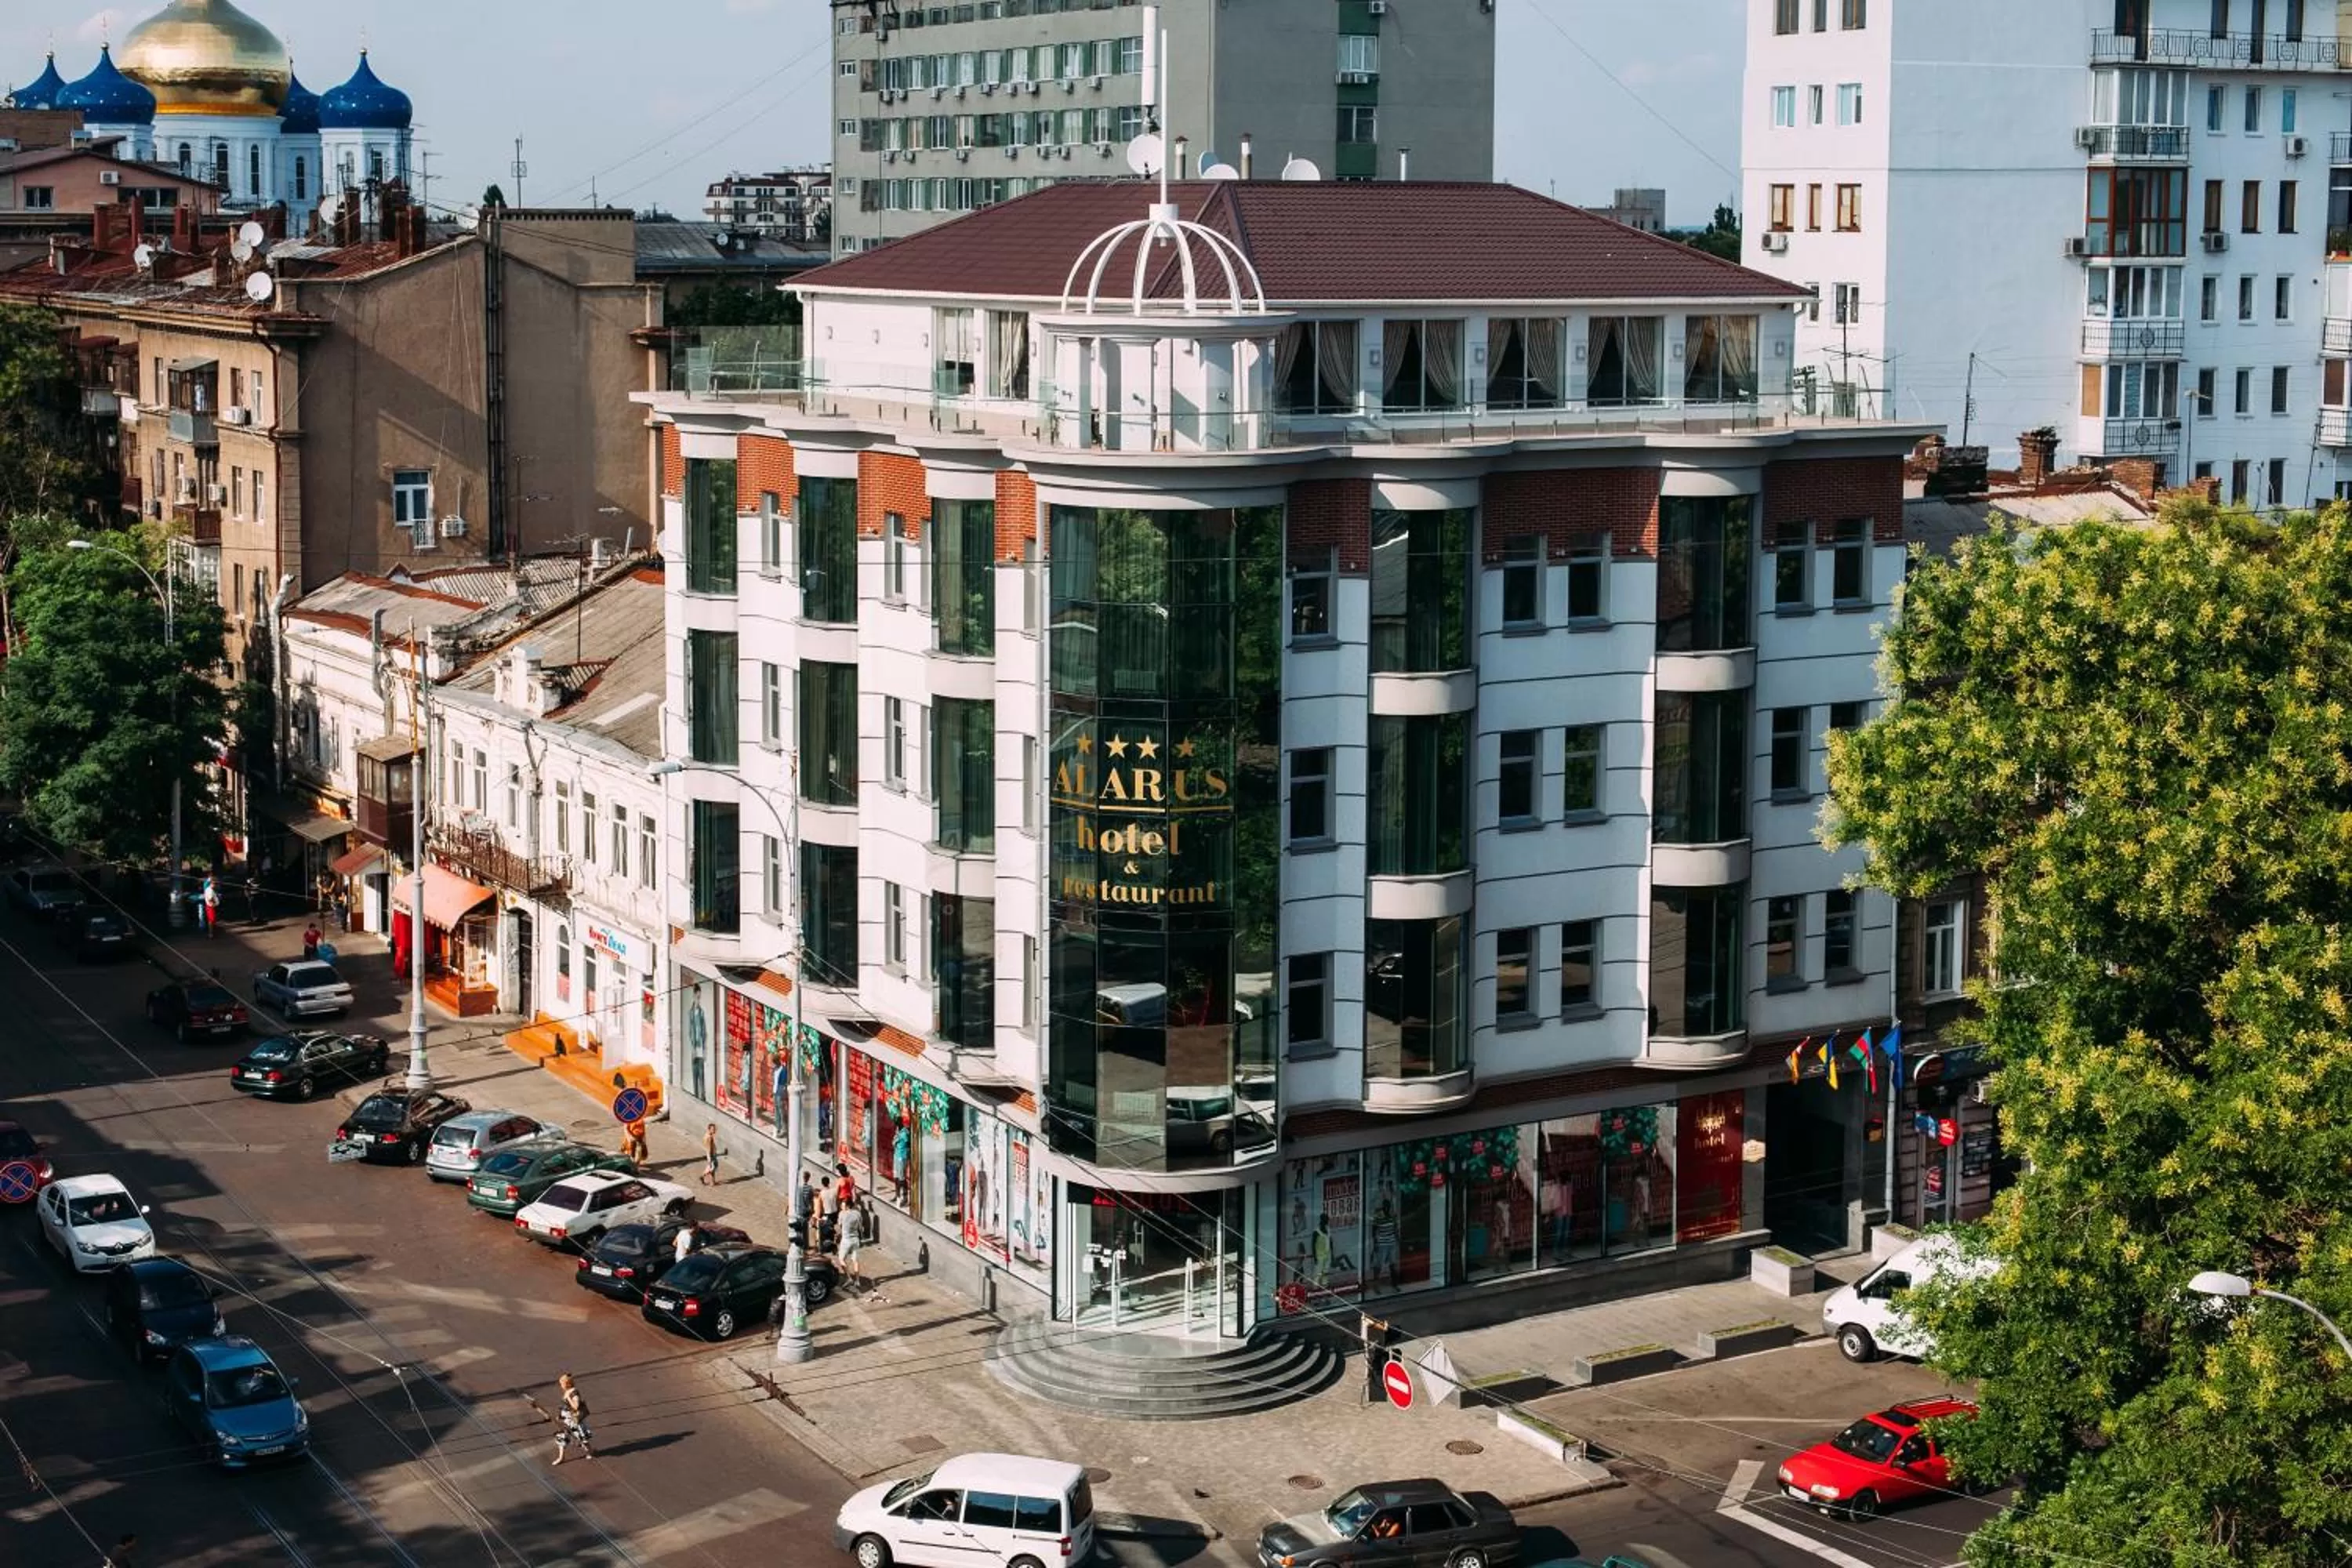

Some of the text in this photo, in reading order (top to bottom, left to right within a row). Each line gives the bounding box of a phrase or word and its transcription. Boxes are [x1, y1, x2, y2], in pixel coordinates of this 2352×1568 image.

[1053, 760, 1227, 801] ALARUS
[1077, 815, 1180, 855] hotel
[1123, 860, 1139, 875] &
[1063, 877, 1216, 904] restaurant
